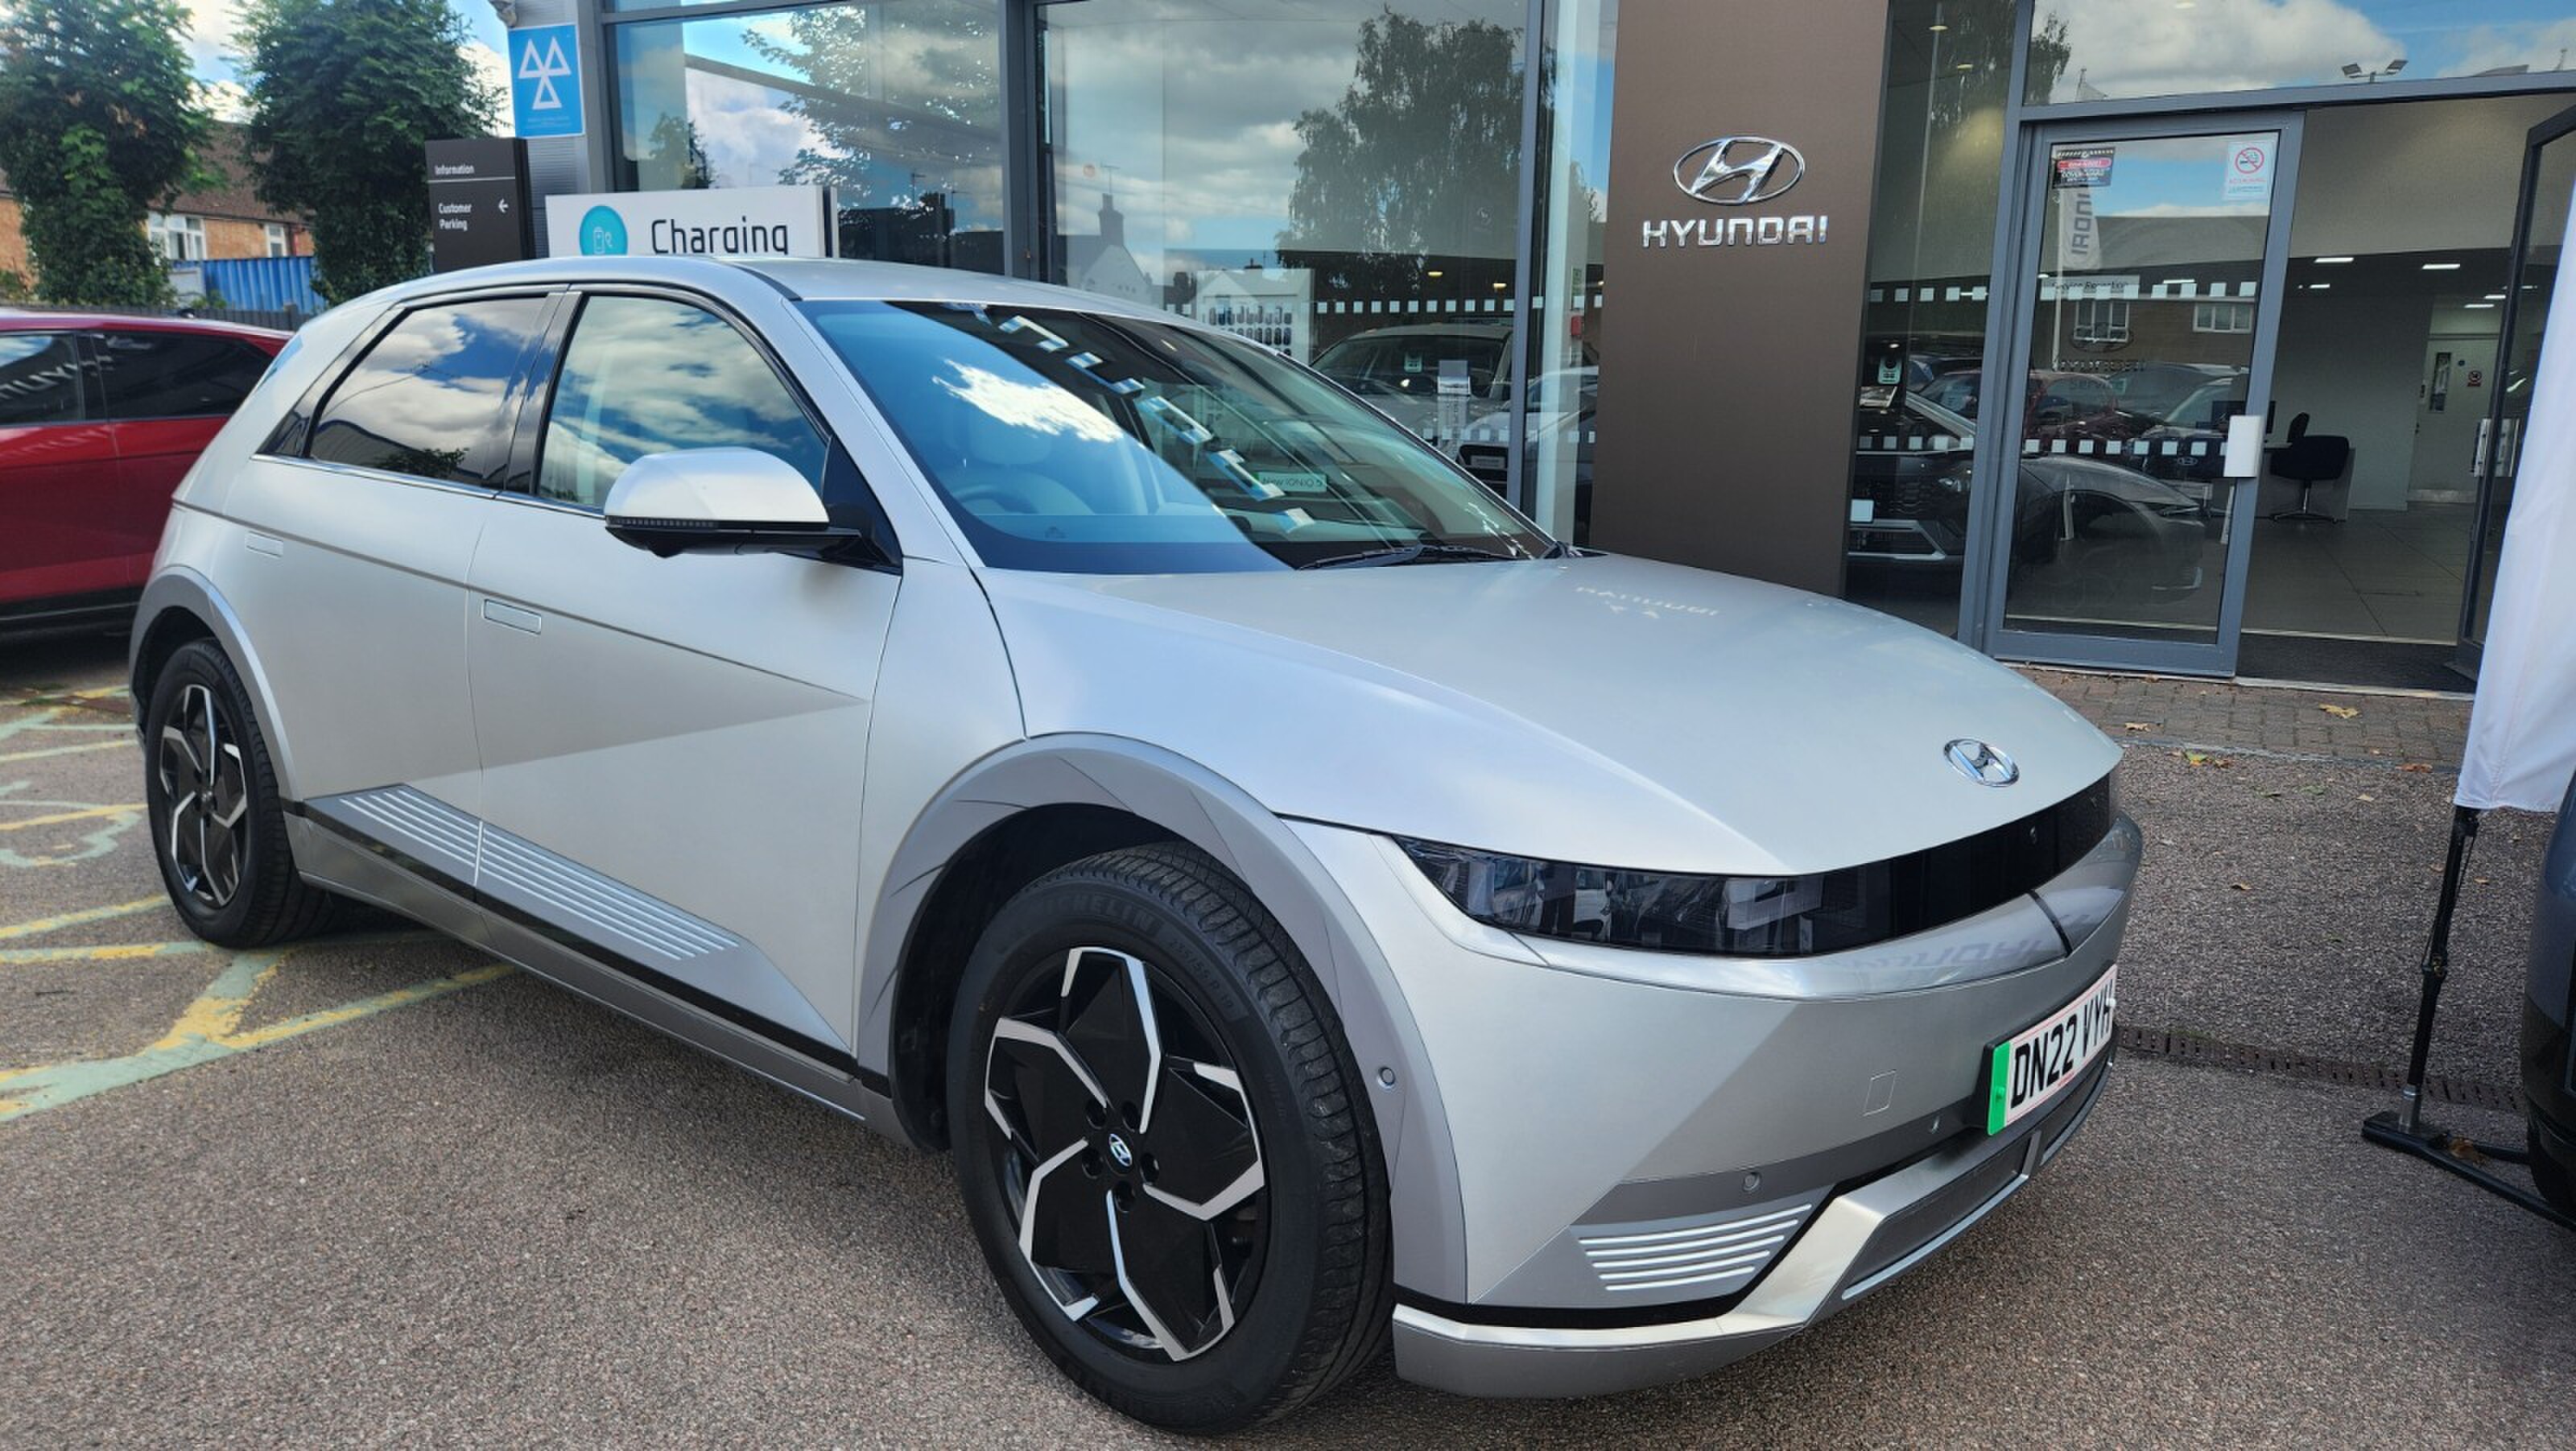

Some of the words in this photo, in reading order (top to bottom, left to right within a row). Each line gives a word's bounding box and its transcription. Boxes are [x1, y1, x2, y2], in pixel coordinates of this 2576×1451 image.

[435, 164, 475, 176] Information
[438, 202, 473, 215] Customer
[439, 218, 469, 232] Parking
[651, 215, 789, 255] Charging
[1642, 216, 1829, 248] HYUNDAI
[2010, 1014, 2078, 1110] DN22
[2082, 978, 2114, 1058] VYH
